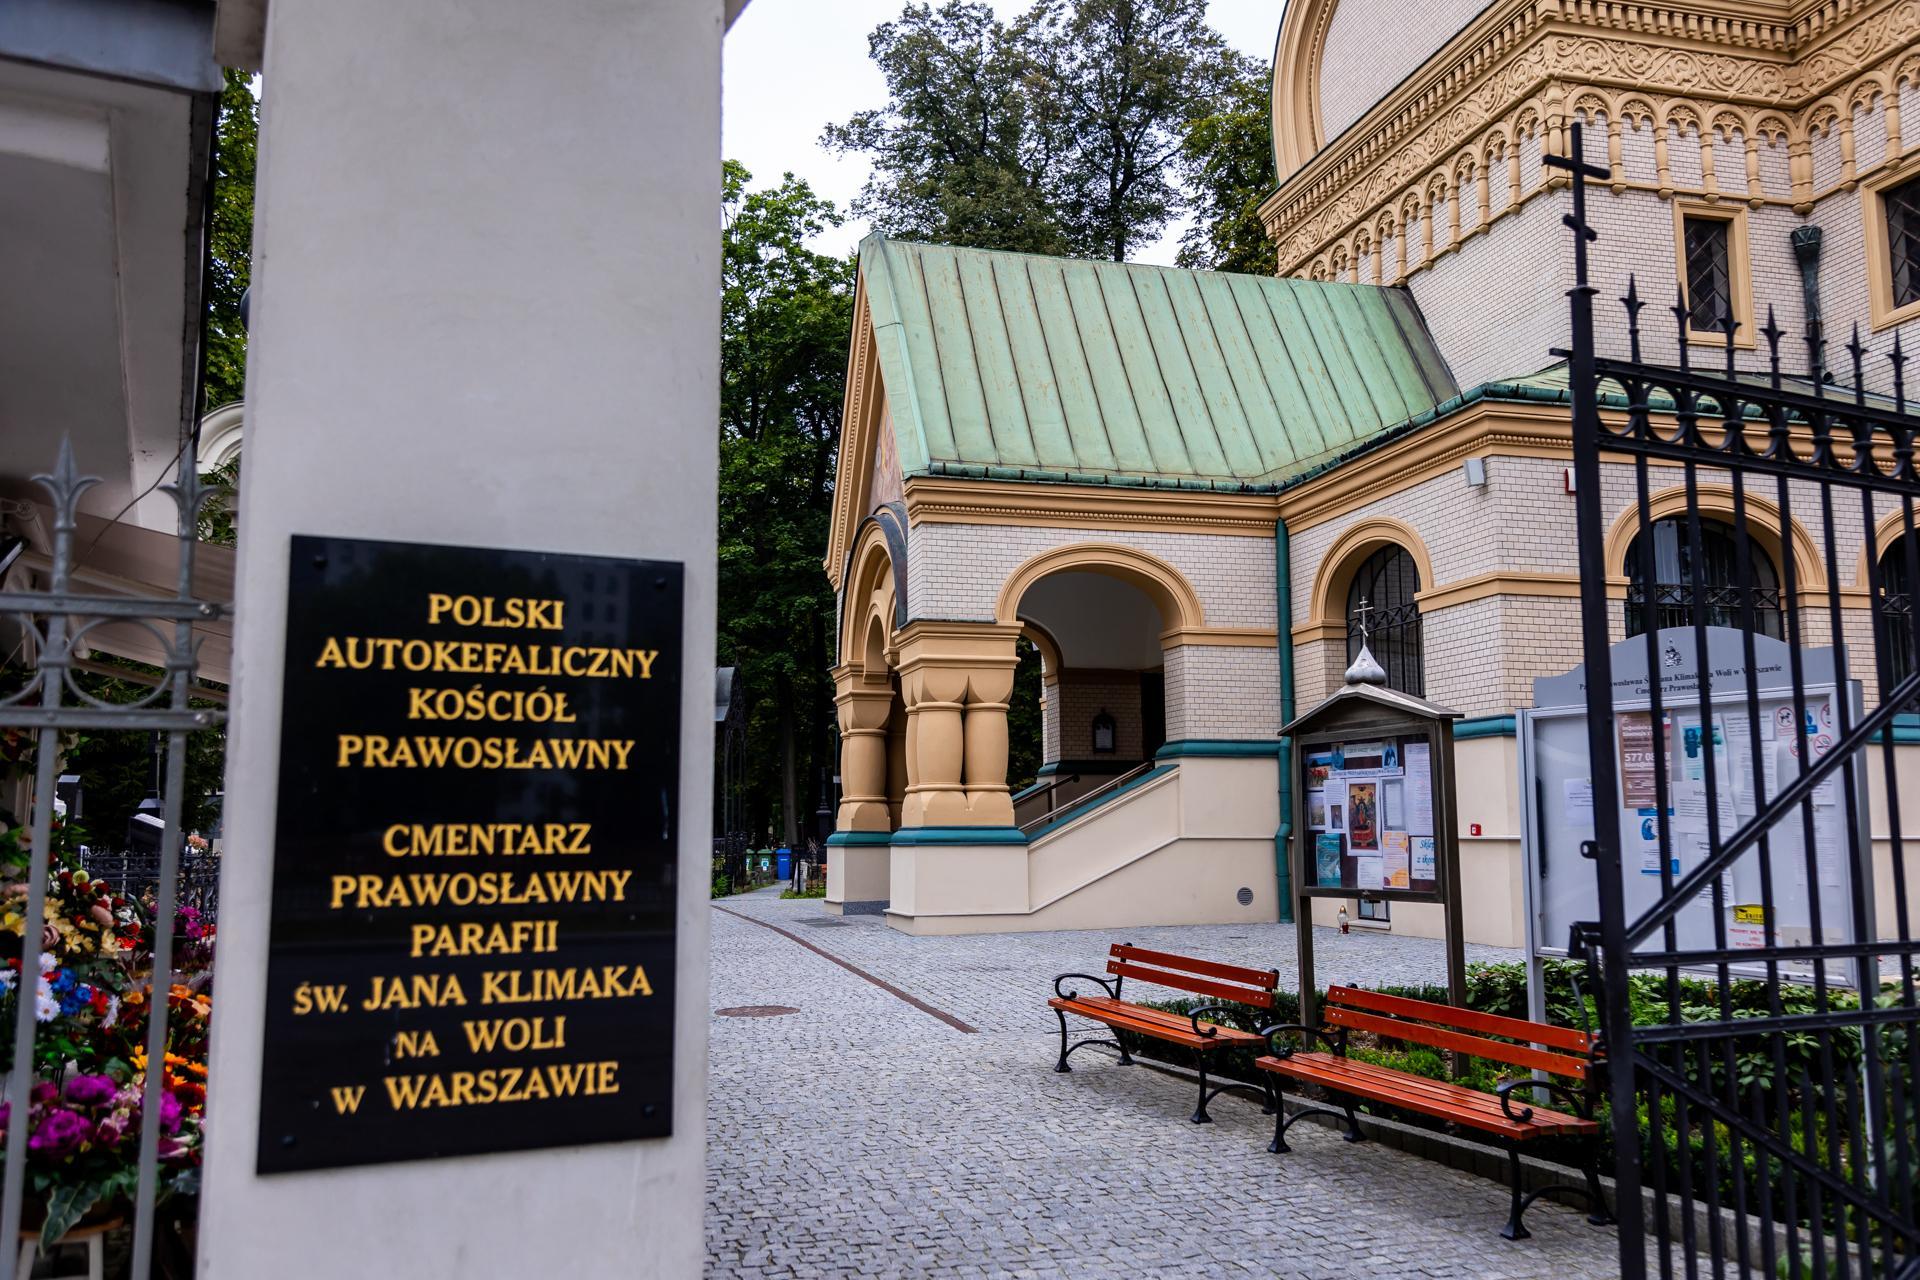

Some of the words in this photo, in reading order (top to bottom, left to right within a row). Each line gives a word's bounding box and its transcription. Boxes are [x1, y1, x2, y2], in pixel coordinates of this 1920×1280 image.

[428, 593, 564, 630] POLSKI
[315, 636, 659, 680] AUTOKEFALICZNY
[1715, 668, 1732, 677] Woli
[408, 684, 577, 723] KOŚCIÓŁ
[337, 734, 635, 770] PRAWOSŁAWNY
[383, 822, 592, 858] CMENTARZ
[330, 869, 632, 909] PRAWOSŁAWNY
[410, 919, 559, 958] PARAFII
[293, 980, 349, 1014] ŚW.
[362, 974, 467, 1012] JANA
[481, 965, 653, 1005] KLIMAKA
[395, 1031, 440, 1058] NA
[463, 1015, 566, 1053] WOLI
[383, 1060, 620, 1110] WARSZAWIE
